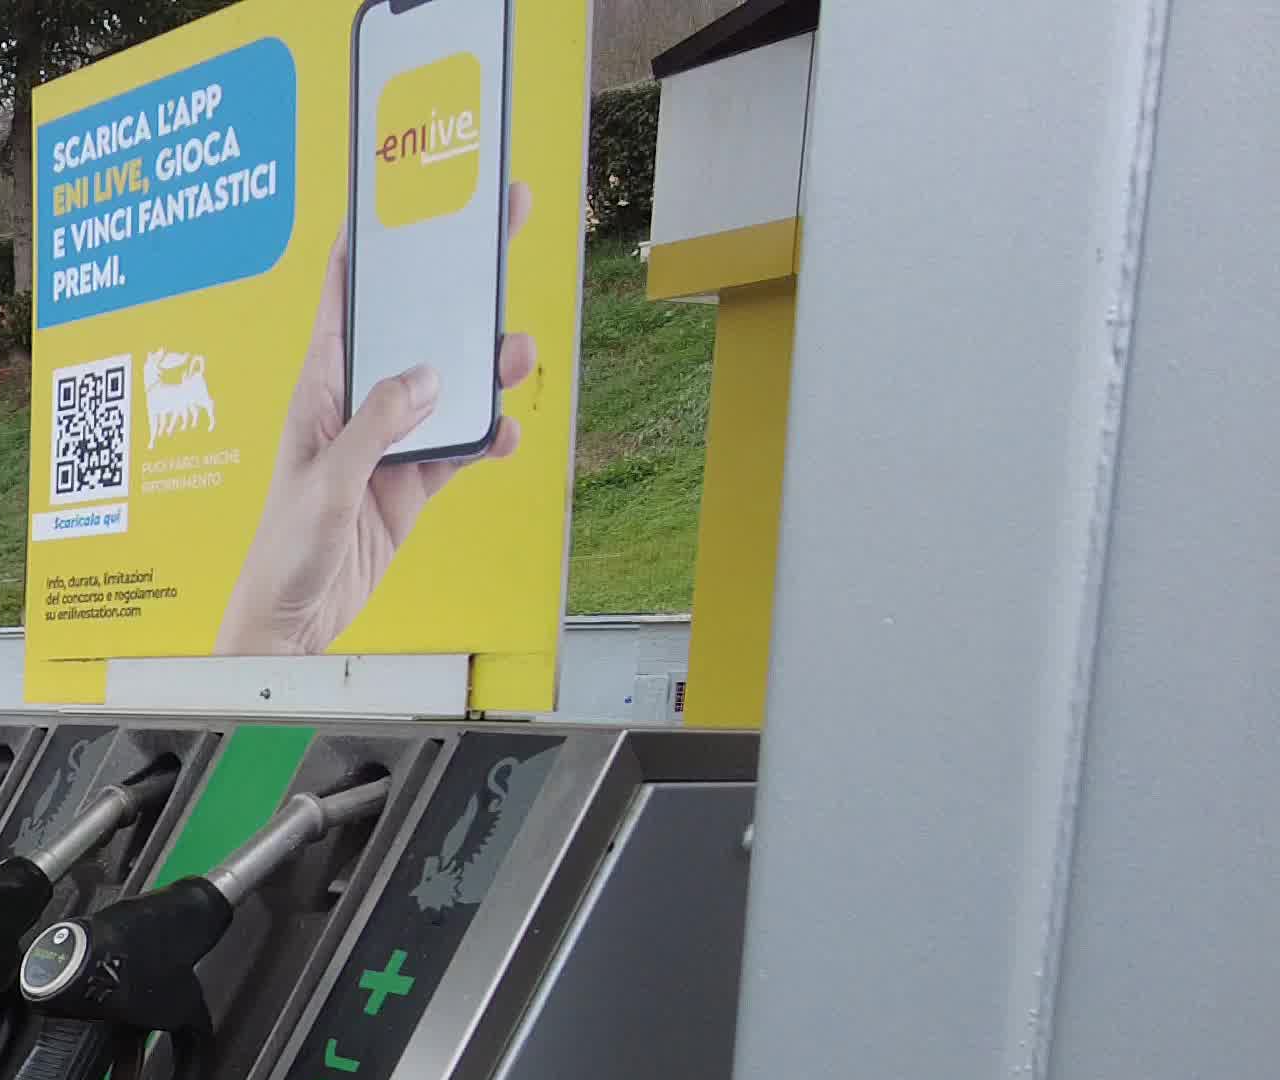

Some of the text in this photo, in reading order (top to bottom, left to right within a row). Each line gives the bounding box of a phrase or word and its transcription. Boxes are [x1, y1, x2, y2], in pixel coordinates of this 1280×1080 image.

[53, 111, 151, 173] SCARICA
[53, 126, 240, 216] ENI LIVE, GIOCA
[53, 160, 276, 259] E VINCI FANTASTICI
[53, 255, 125, 301] PREMI.
[103, 509, 121, 526] qui
